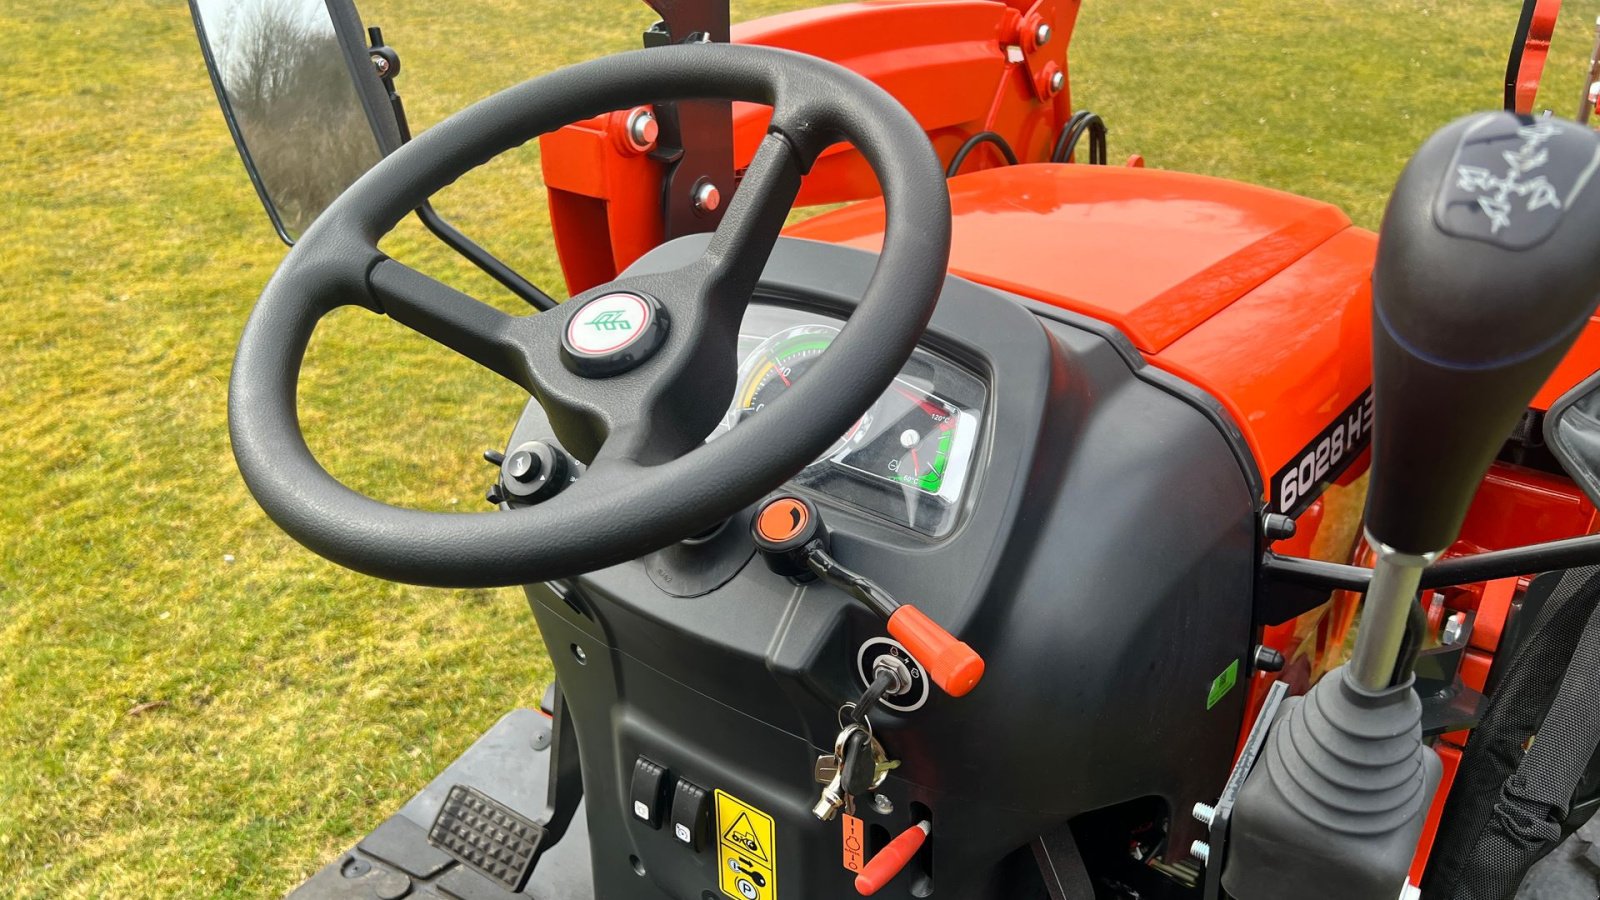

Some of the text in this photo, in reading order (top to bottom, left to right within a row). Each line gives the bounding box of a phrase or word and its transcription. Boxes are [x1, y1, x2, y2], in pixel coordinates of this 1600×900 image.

[931, 413, 950, 424] 120°C
[1280, 424, 1345, 513] 6028
[743, 883, 752, 893] P
